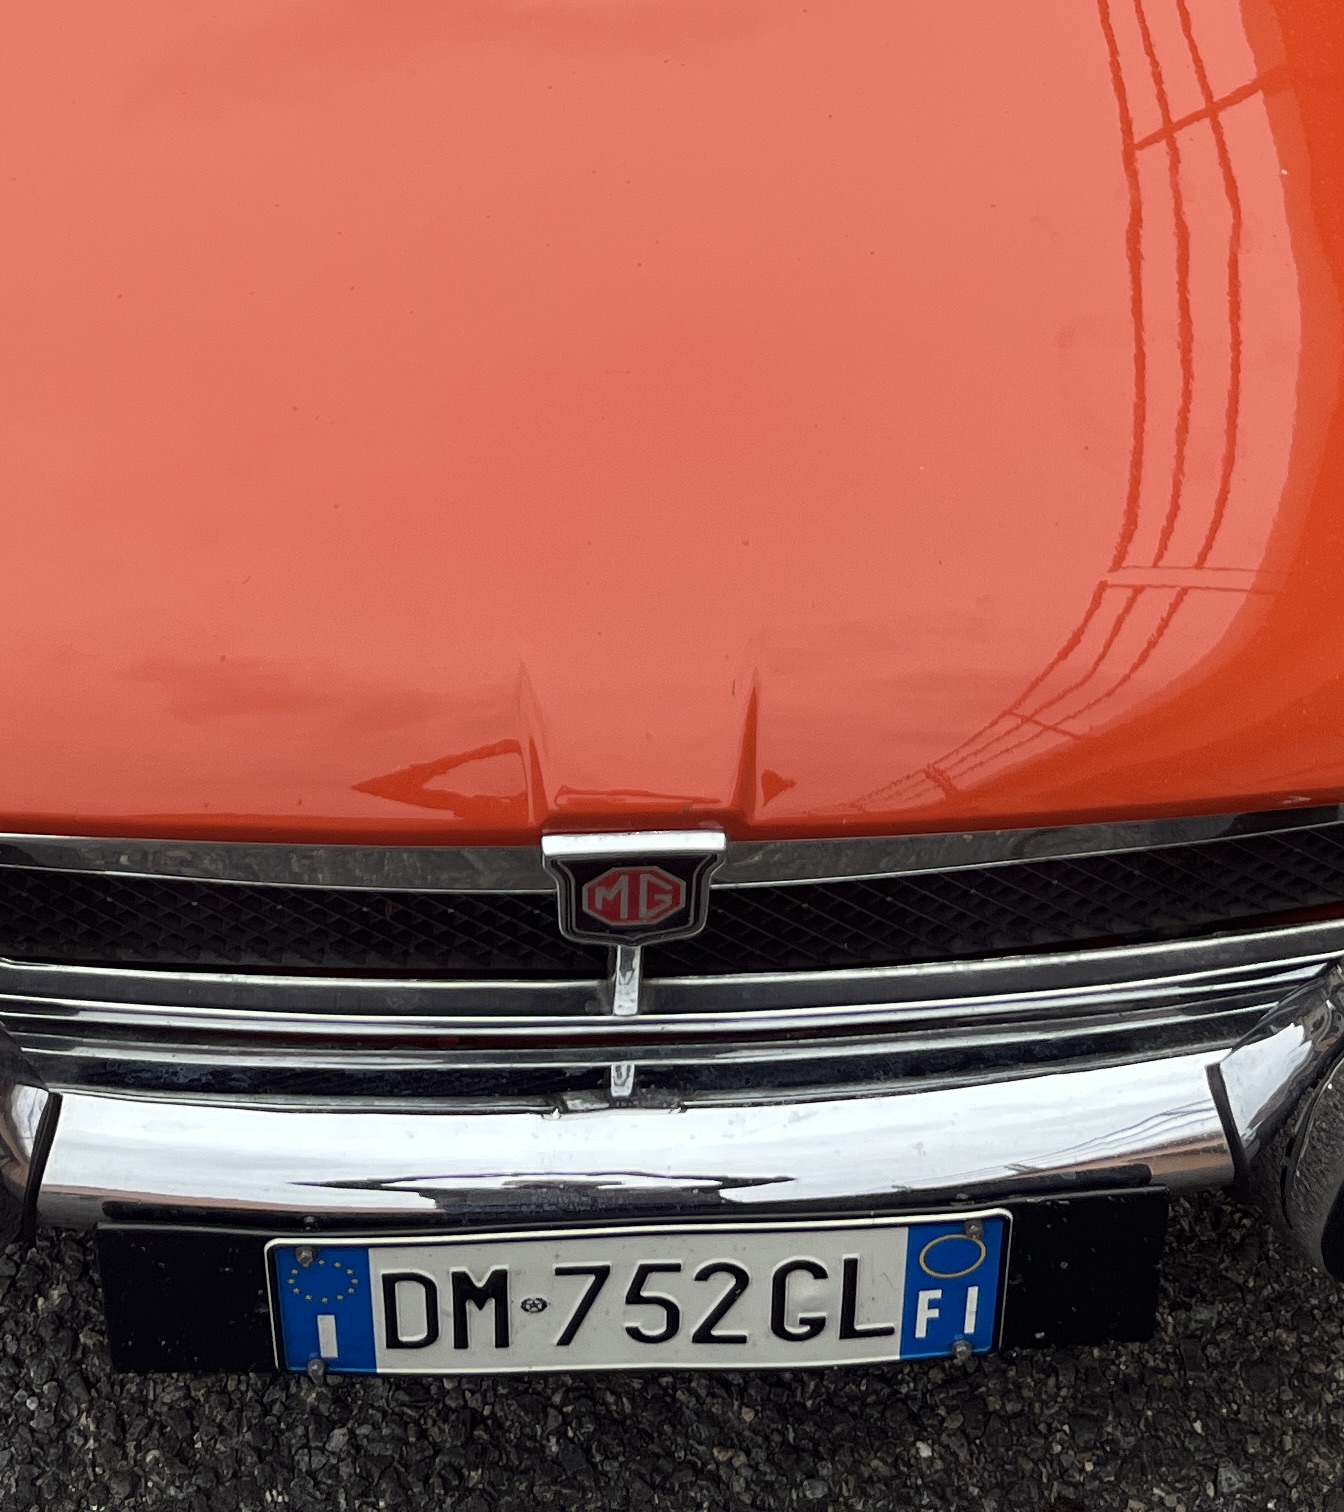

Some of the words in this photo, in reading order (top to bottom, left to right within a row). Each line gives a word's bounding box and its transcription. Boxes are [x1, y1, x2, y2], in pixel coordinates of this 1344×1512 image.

[595, 873, 673, 919] MG
[317, 1313, 339, 1358] I
[380, 1267, 511, 1350] DM
[553, 1256, 896, 1346] 752GL
[914, 1285, 980, 1339] FI
